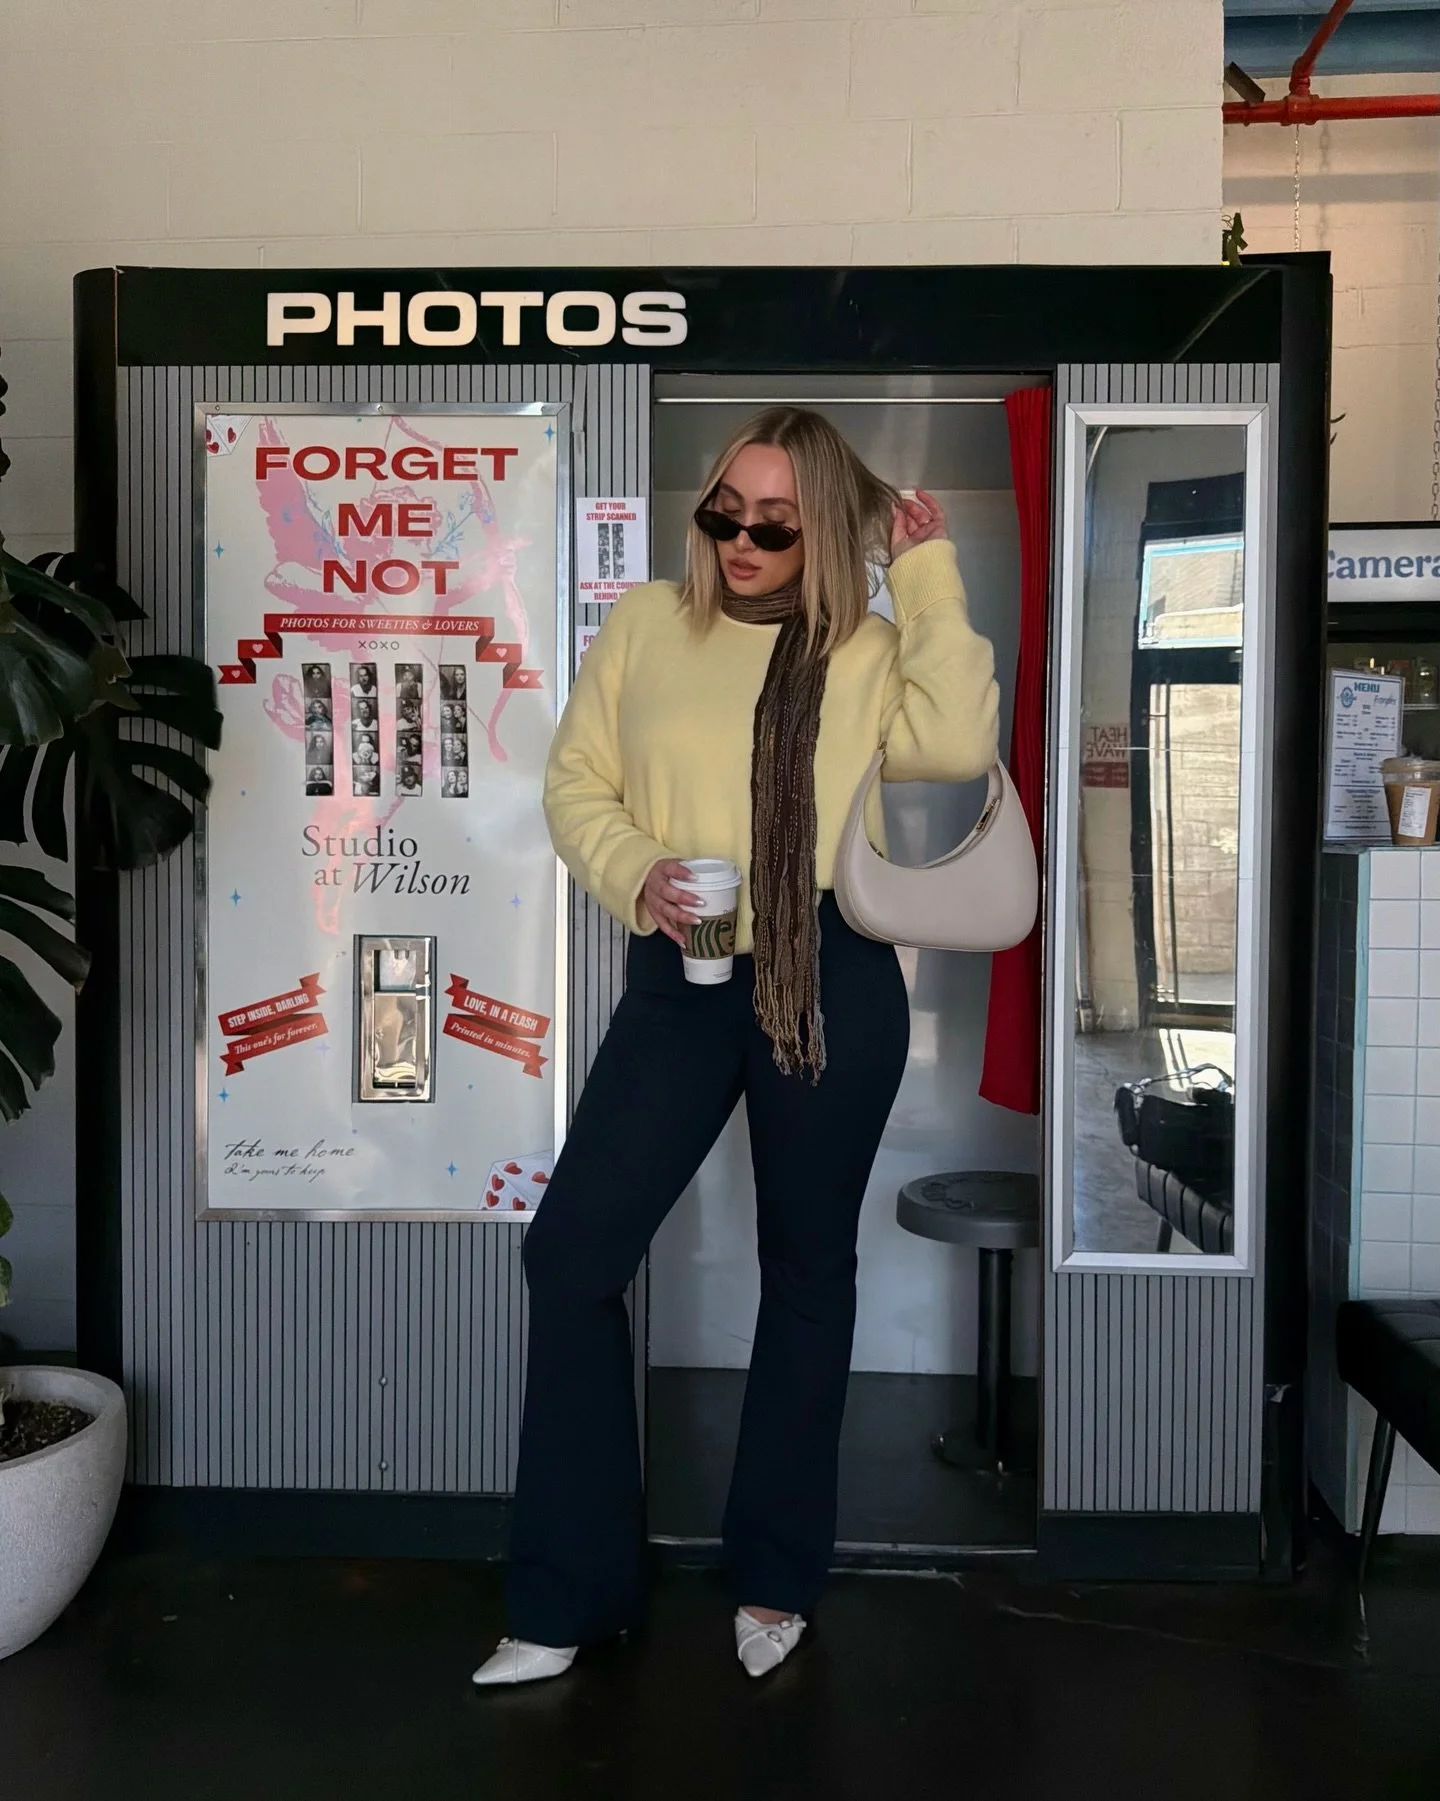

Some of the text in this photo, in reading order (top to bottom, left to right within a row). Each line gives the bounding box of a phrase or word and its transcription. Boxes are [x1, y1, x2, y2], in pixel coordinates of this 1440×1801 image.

[266, 290, 688, 347] PHOTOS
[255, 446, 519, 481] FORGET
[586, 513, 637, 521] STRIP SCANNED
[595, 502, 626, 511] GET YOUR
[337, 503, 433, 537] ME
[322, 559, 460, 596] NOT
[580, 581, 593, 590] ASK
[593, 581, 602, 590] AT
[603, 581, 615, 590] THE
[280, 616, 480, 632] PHOTOS FOR SWEETIES & LOVERS
[358, 640, 400, 650] XOXO
[1354, 681, 1381, 693] MENU
[301, 825, 418, 858] Studio
[314, 860, 471, 895] at Wilson
[228, 993, 310, 1029] STEP INSIDE, DARLING
[463, 995, 538, 1032] LOVE, IN A FLASH
[234, 1043, 252, 1055] This
[252, 1034, 272, 1049] one's
[272, 1032, 286, 1046] for
[450, 1022, 484, 1040] Printed
[484, 1034, 494, 1044] in
[273, 1147, 300, 1158] me
[304, 1138, 356, 1160] home
